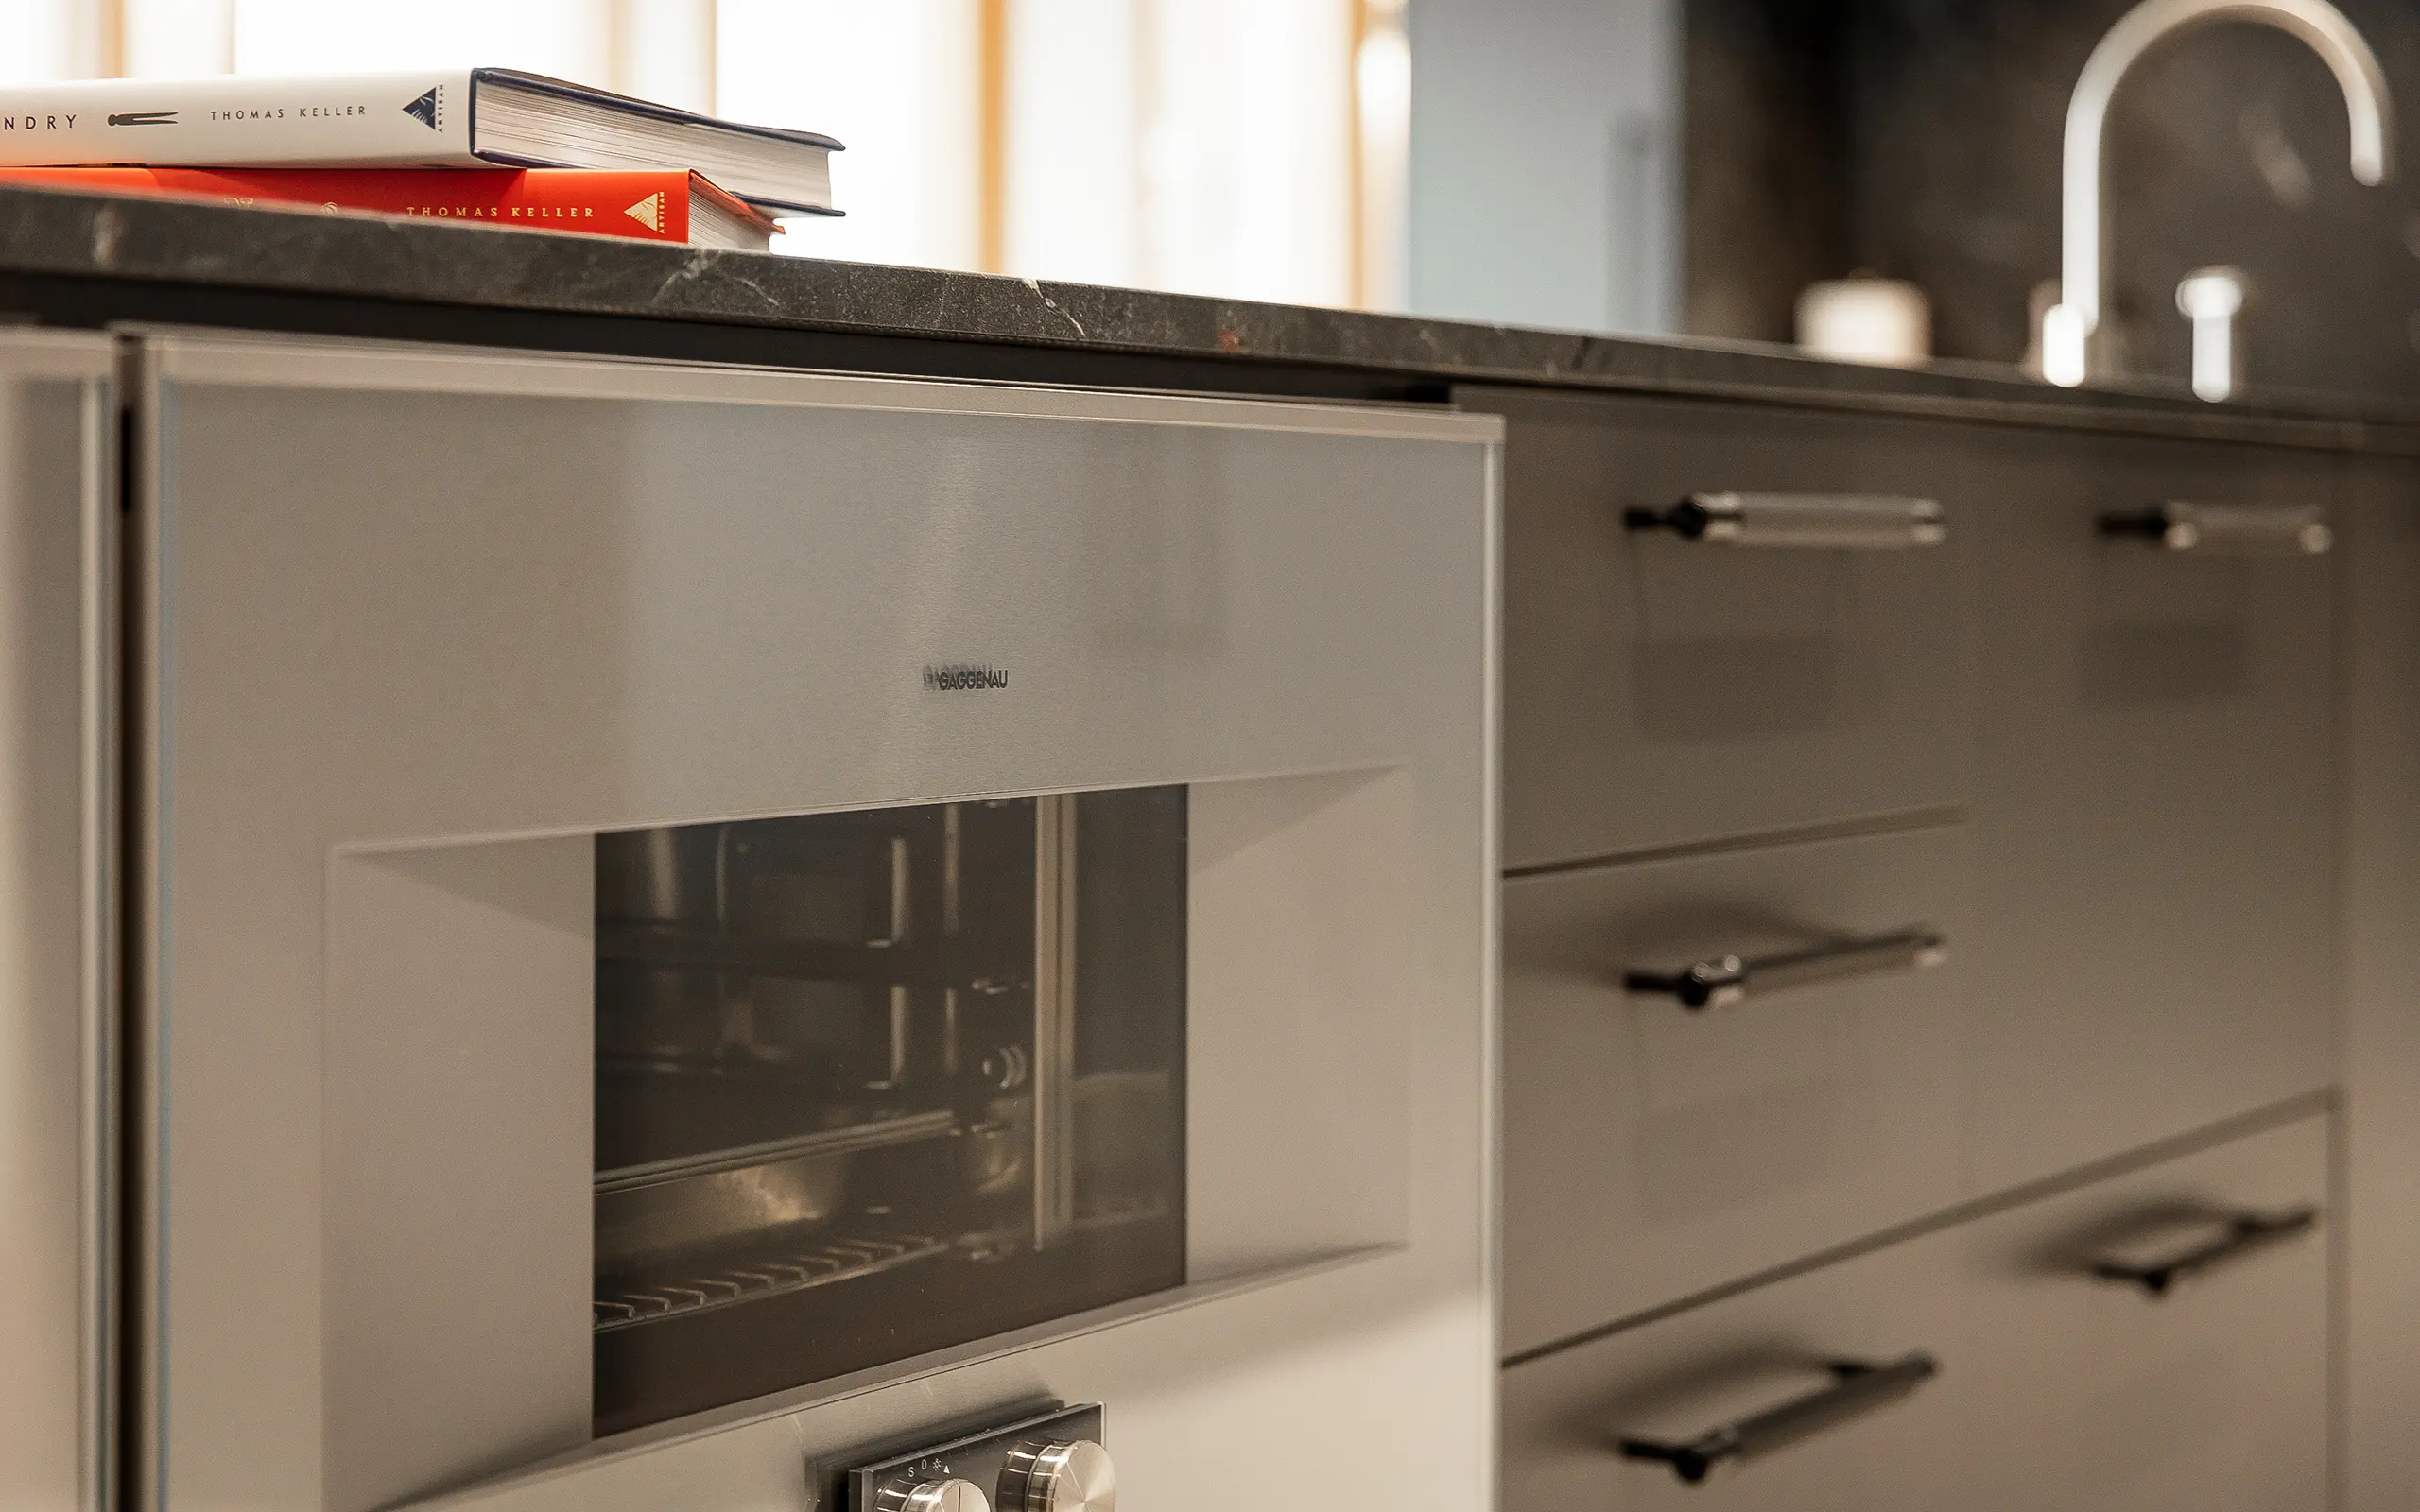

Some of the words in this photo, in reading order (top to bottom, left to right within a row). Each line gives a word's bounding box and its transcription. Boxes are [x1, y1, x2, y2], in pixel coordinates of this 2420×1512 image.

[210, 108, 284, 121] THOMAS
[299, 105, 366, 118] KELLER
[4, 114, 77, 130] NDRY
[406, 207, 498, 217] THOMAS
[511, 207, 595, 217] KELLER
[938, 669, 1009, 691] GAGGENAU
